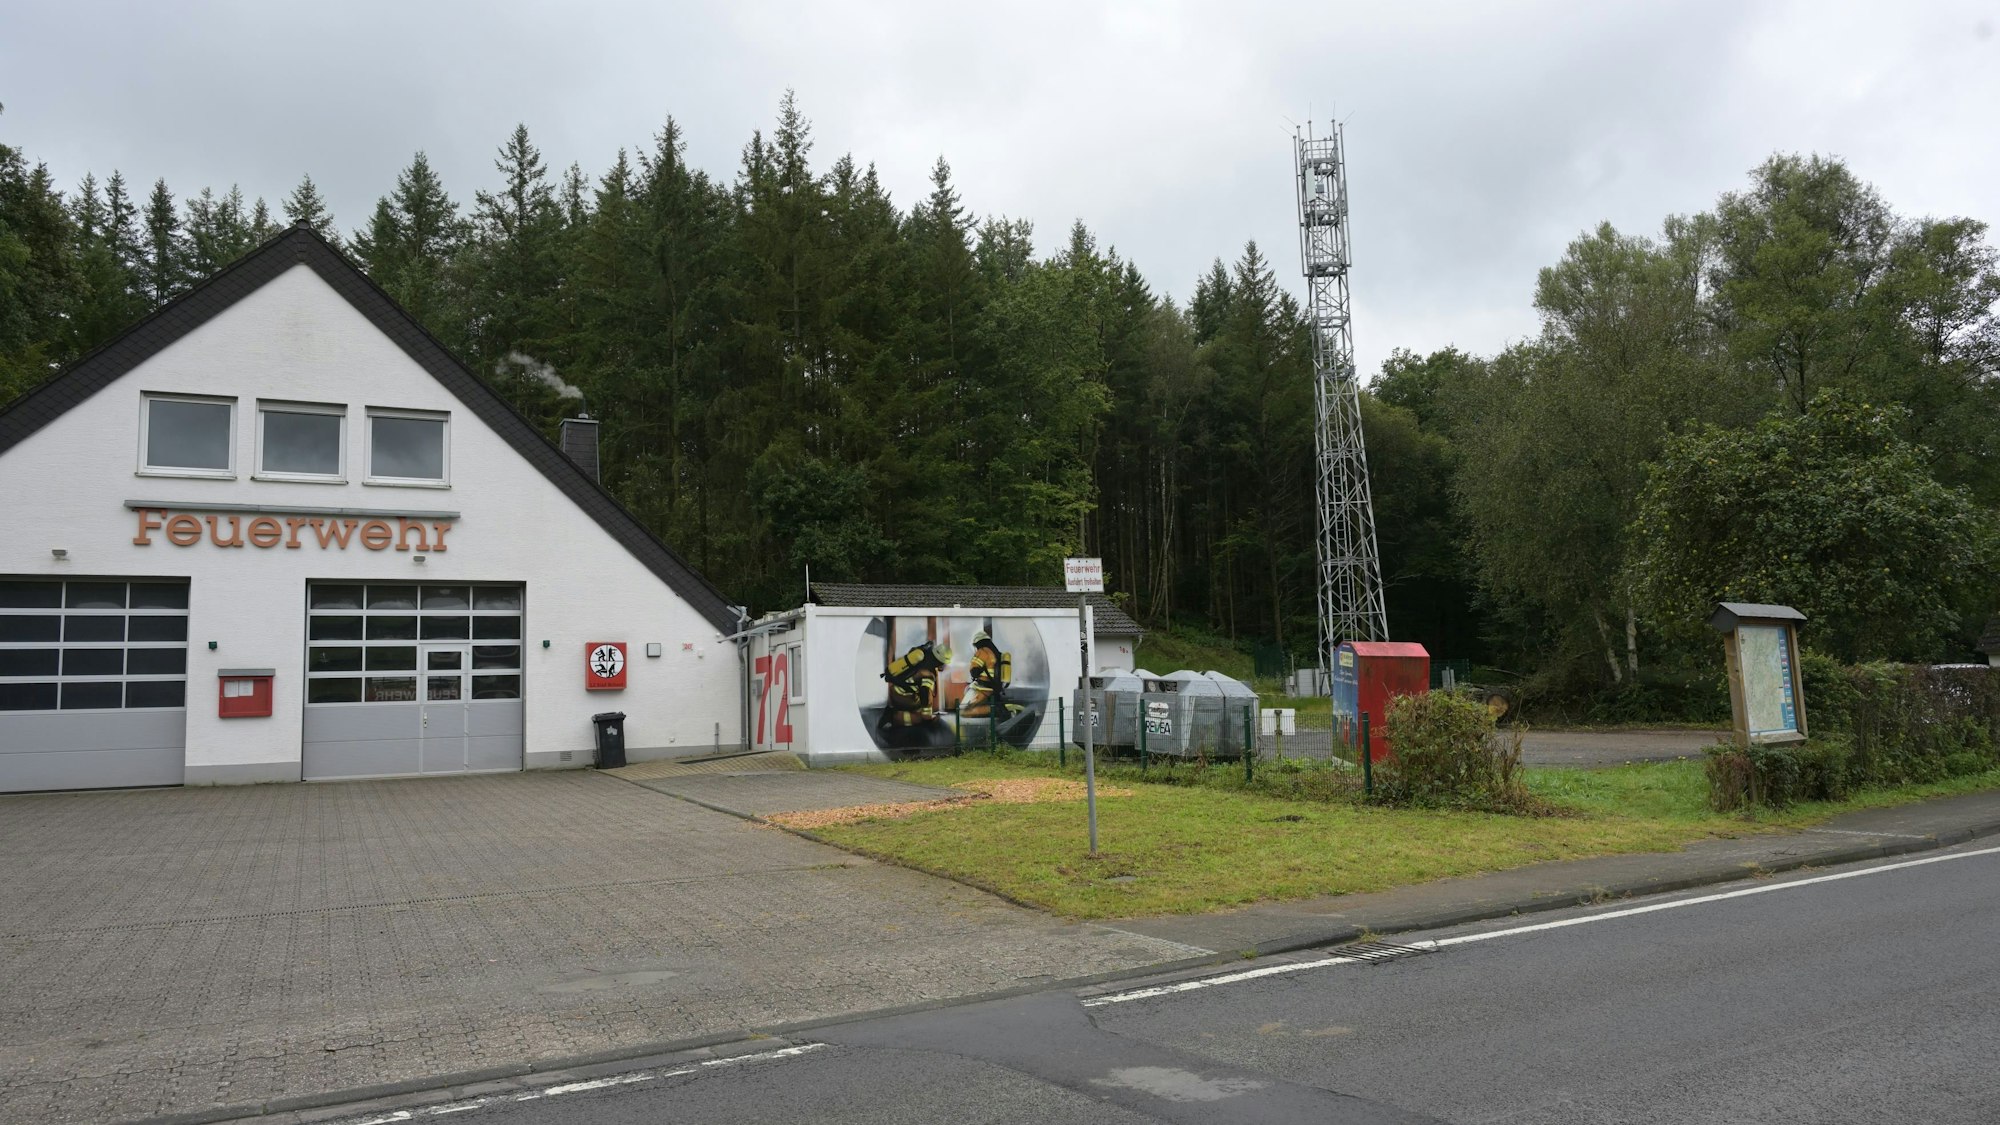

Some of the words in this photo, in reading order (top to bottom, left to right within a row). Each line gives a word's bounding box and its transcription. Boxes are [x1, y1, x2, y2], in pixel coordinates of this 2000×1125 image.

[132, 507, 452, 551] Feuerwehr
[1066, 563, 1101, 574] Feuerwehr
[755, 653, 793, 745] 72
